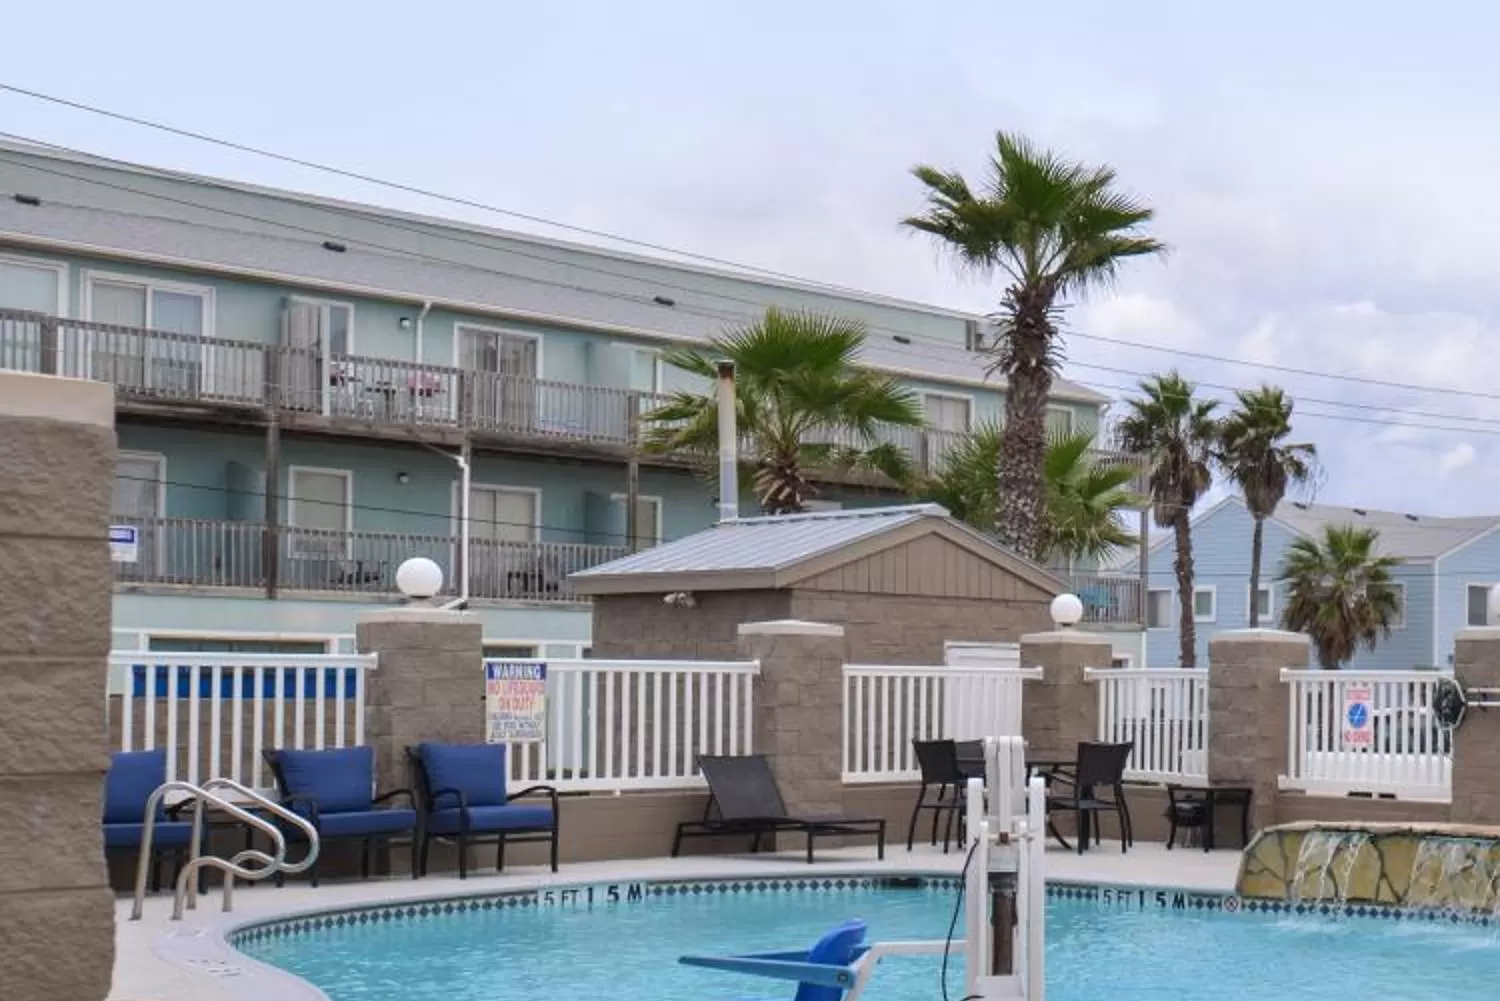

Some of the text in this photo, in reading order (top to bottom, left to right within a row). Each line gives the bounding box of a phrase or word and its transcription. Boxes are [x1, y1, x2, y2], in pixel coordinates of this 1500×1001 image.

[492, 664, 541, 680] WARNING
[627, 883, 642, 902] M
[1172, 891, 1186, 910] M
